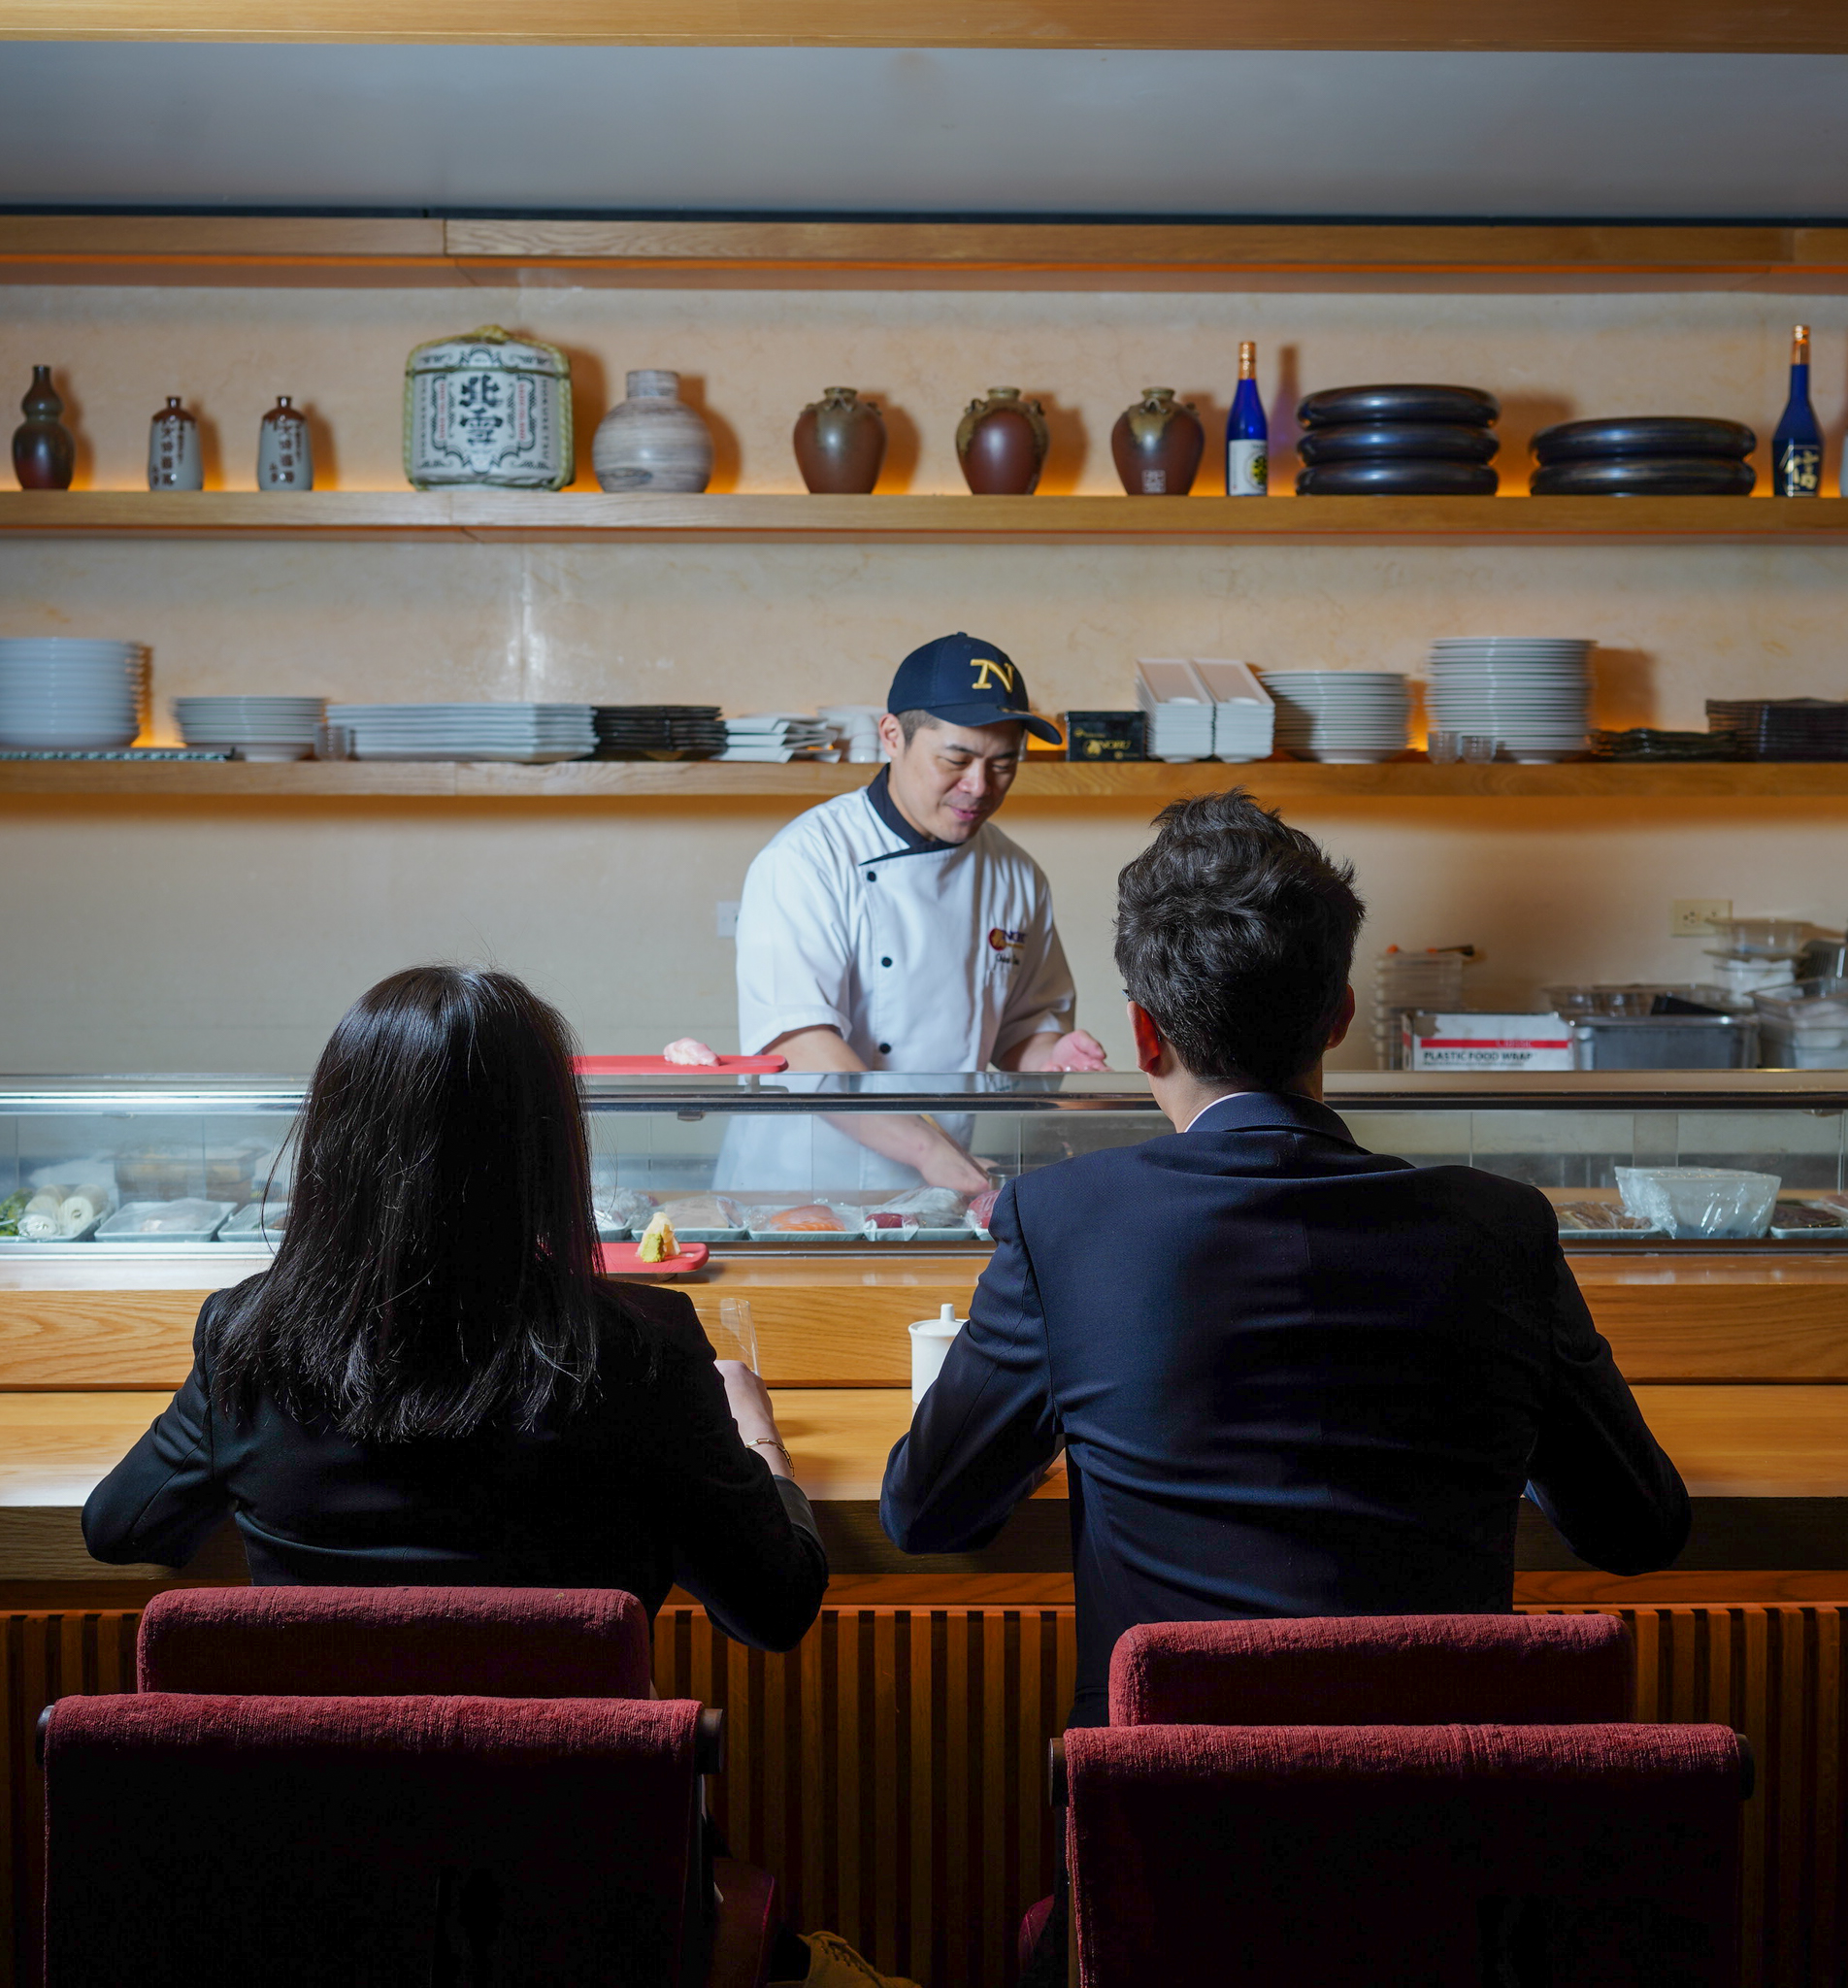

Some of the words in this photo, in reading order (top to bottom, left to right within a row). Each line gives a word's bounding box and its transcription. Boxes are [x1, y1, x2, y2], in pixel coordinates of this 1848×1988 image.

[459, 374, 504, 446] 北雪
[970, 659, 1014, 693] N
[1424, 1051, 1467, 1062] PLASTIC
[1469, 1051, 1500, 1062] FOOD
[1502, 1051, 1533, 1062] WRAP
